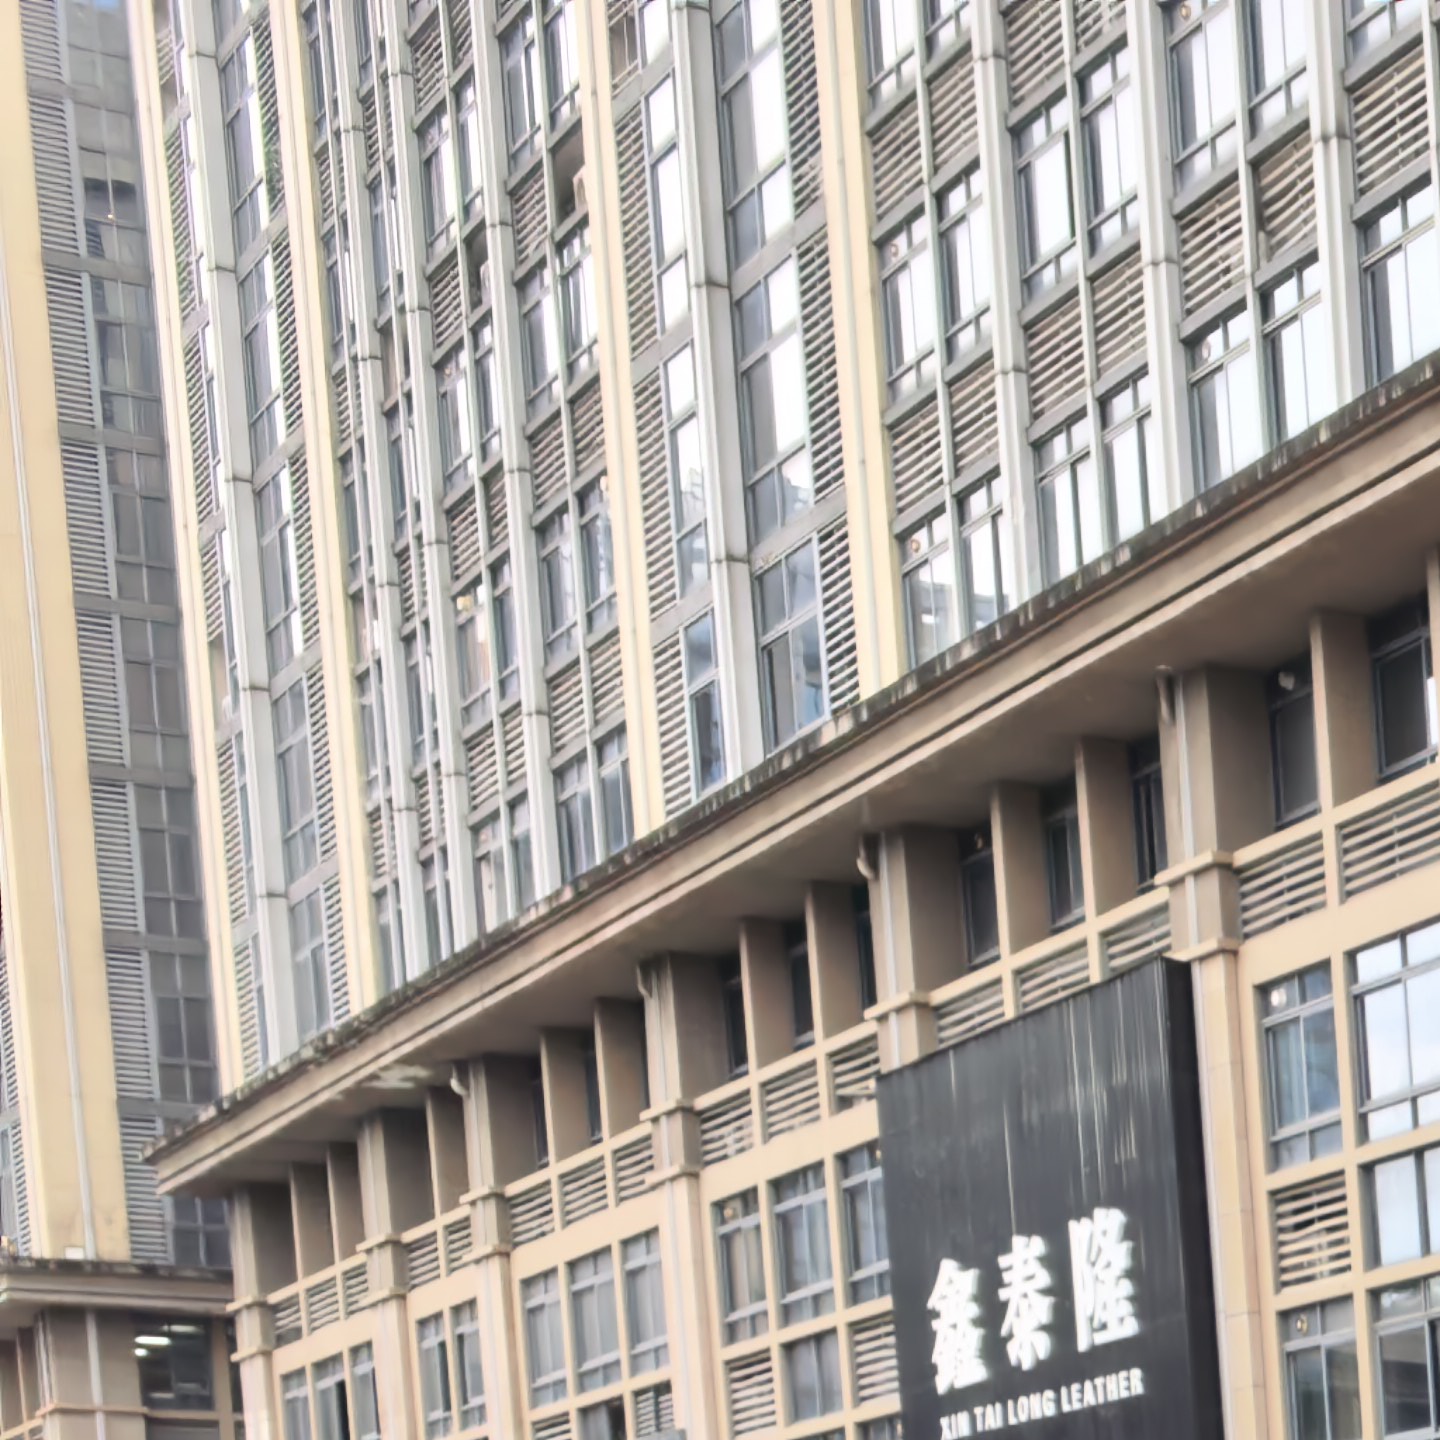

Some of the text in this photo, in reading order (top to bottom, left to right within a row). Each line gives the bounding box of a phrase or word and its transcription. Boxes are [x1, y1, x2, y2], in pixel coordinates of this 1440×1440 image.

[926, 1207, 1142, 1395] 鑫泰隆
[973, 1401, 1004, 1433] TAI
[1007, 1389, 1057, 1426] LONG
[1060, 1367, 1145, 1414] LEATHER
